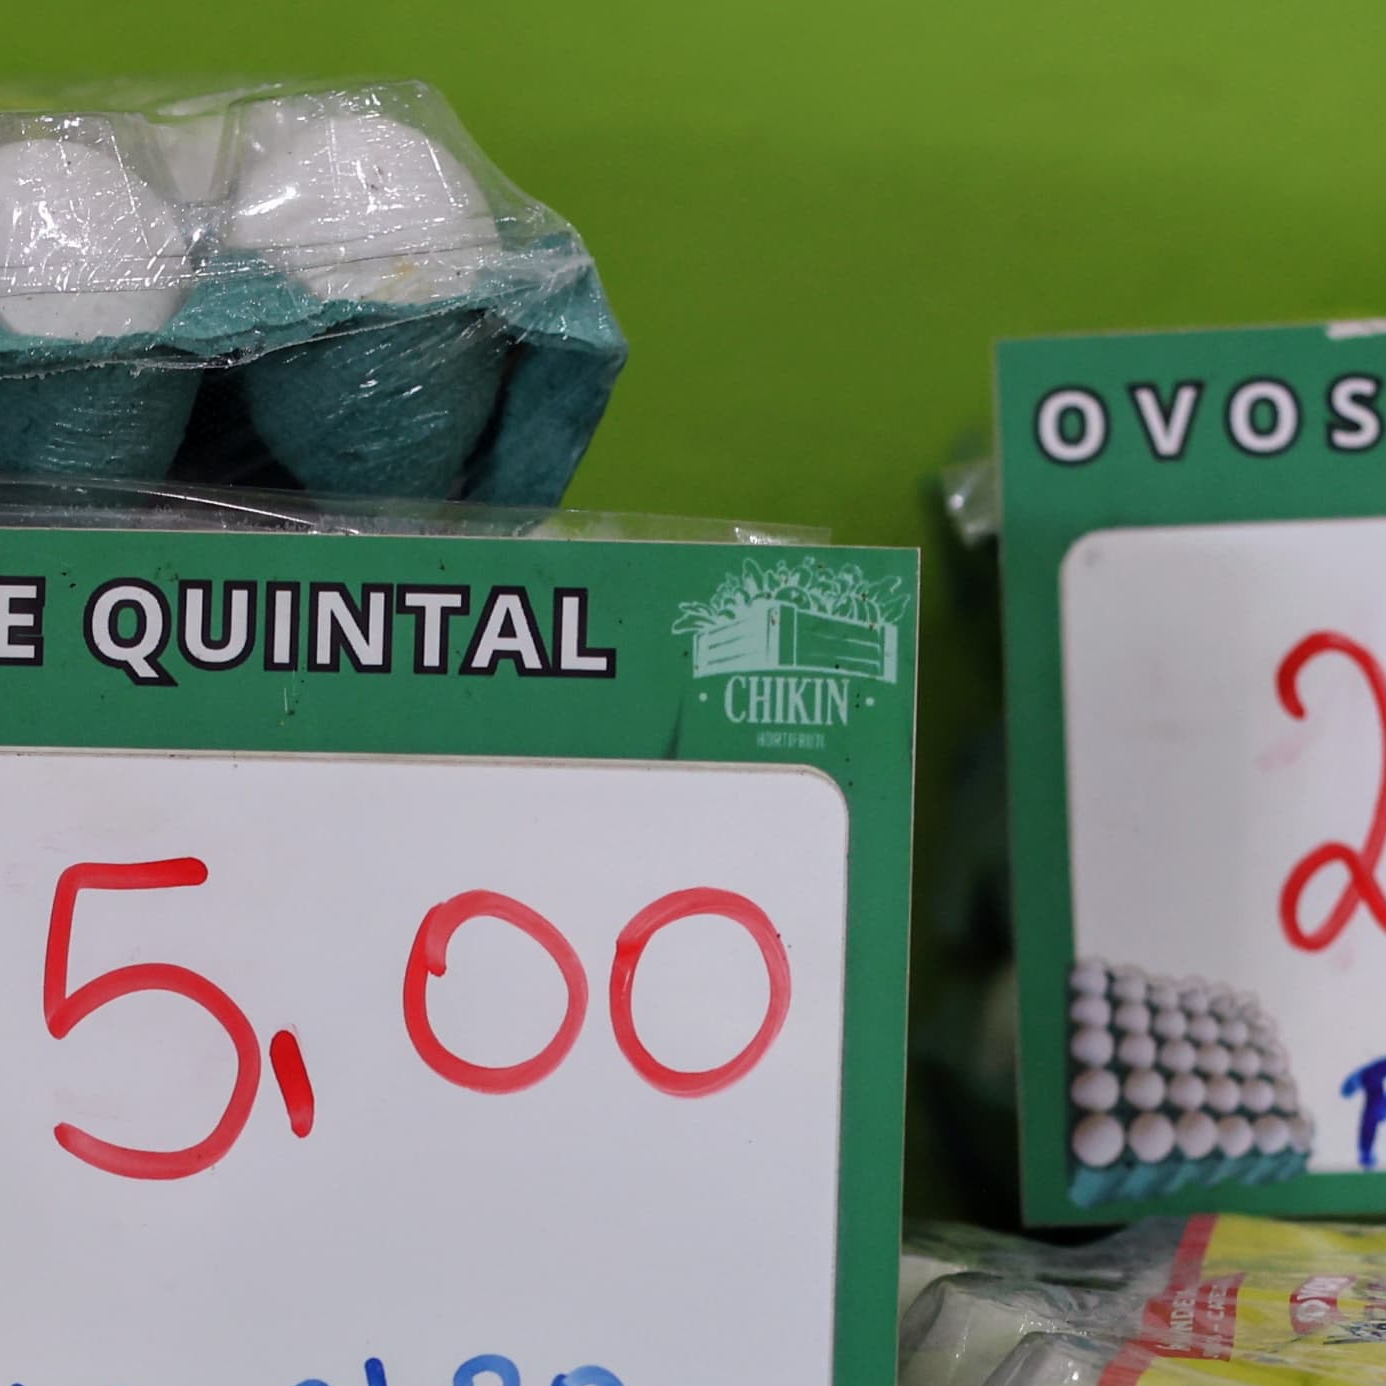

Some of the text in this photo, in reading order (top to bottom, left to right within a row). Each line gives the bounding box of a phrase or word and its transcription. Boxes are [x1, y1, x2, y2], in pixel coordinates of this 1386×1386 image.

[1032, 371, 1386, 469] OVOS
[81, 576, 618, 688] QUINTAL
[724, 675, 850, 725] CHIKIN
